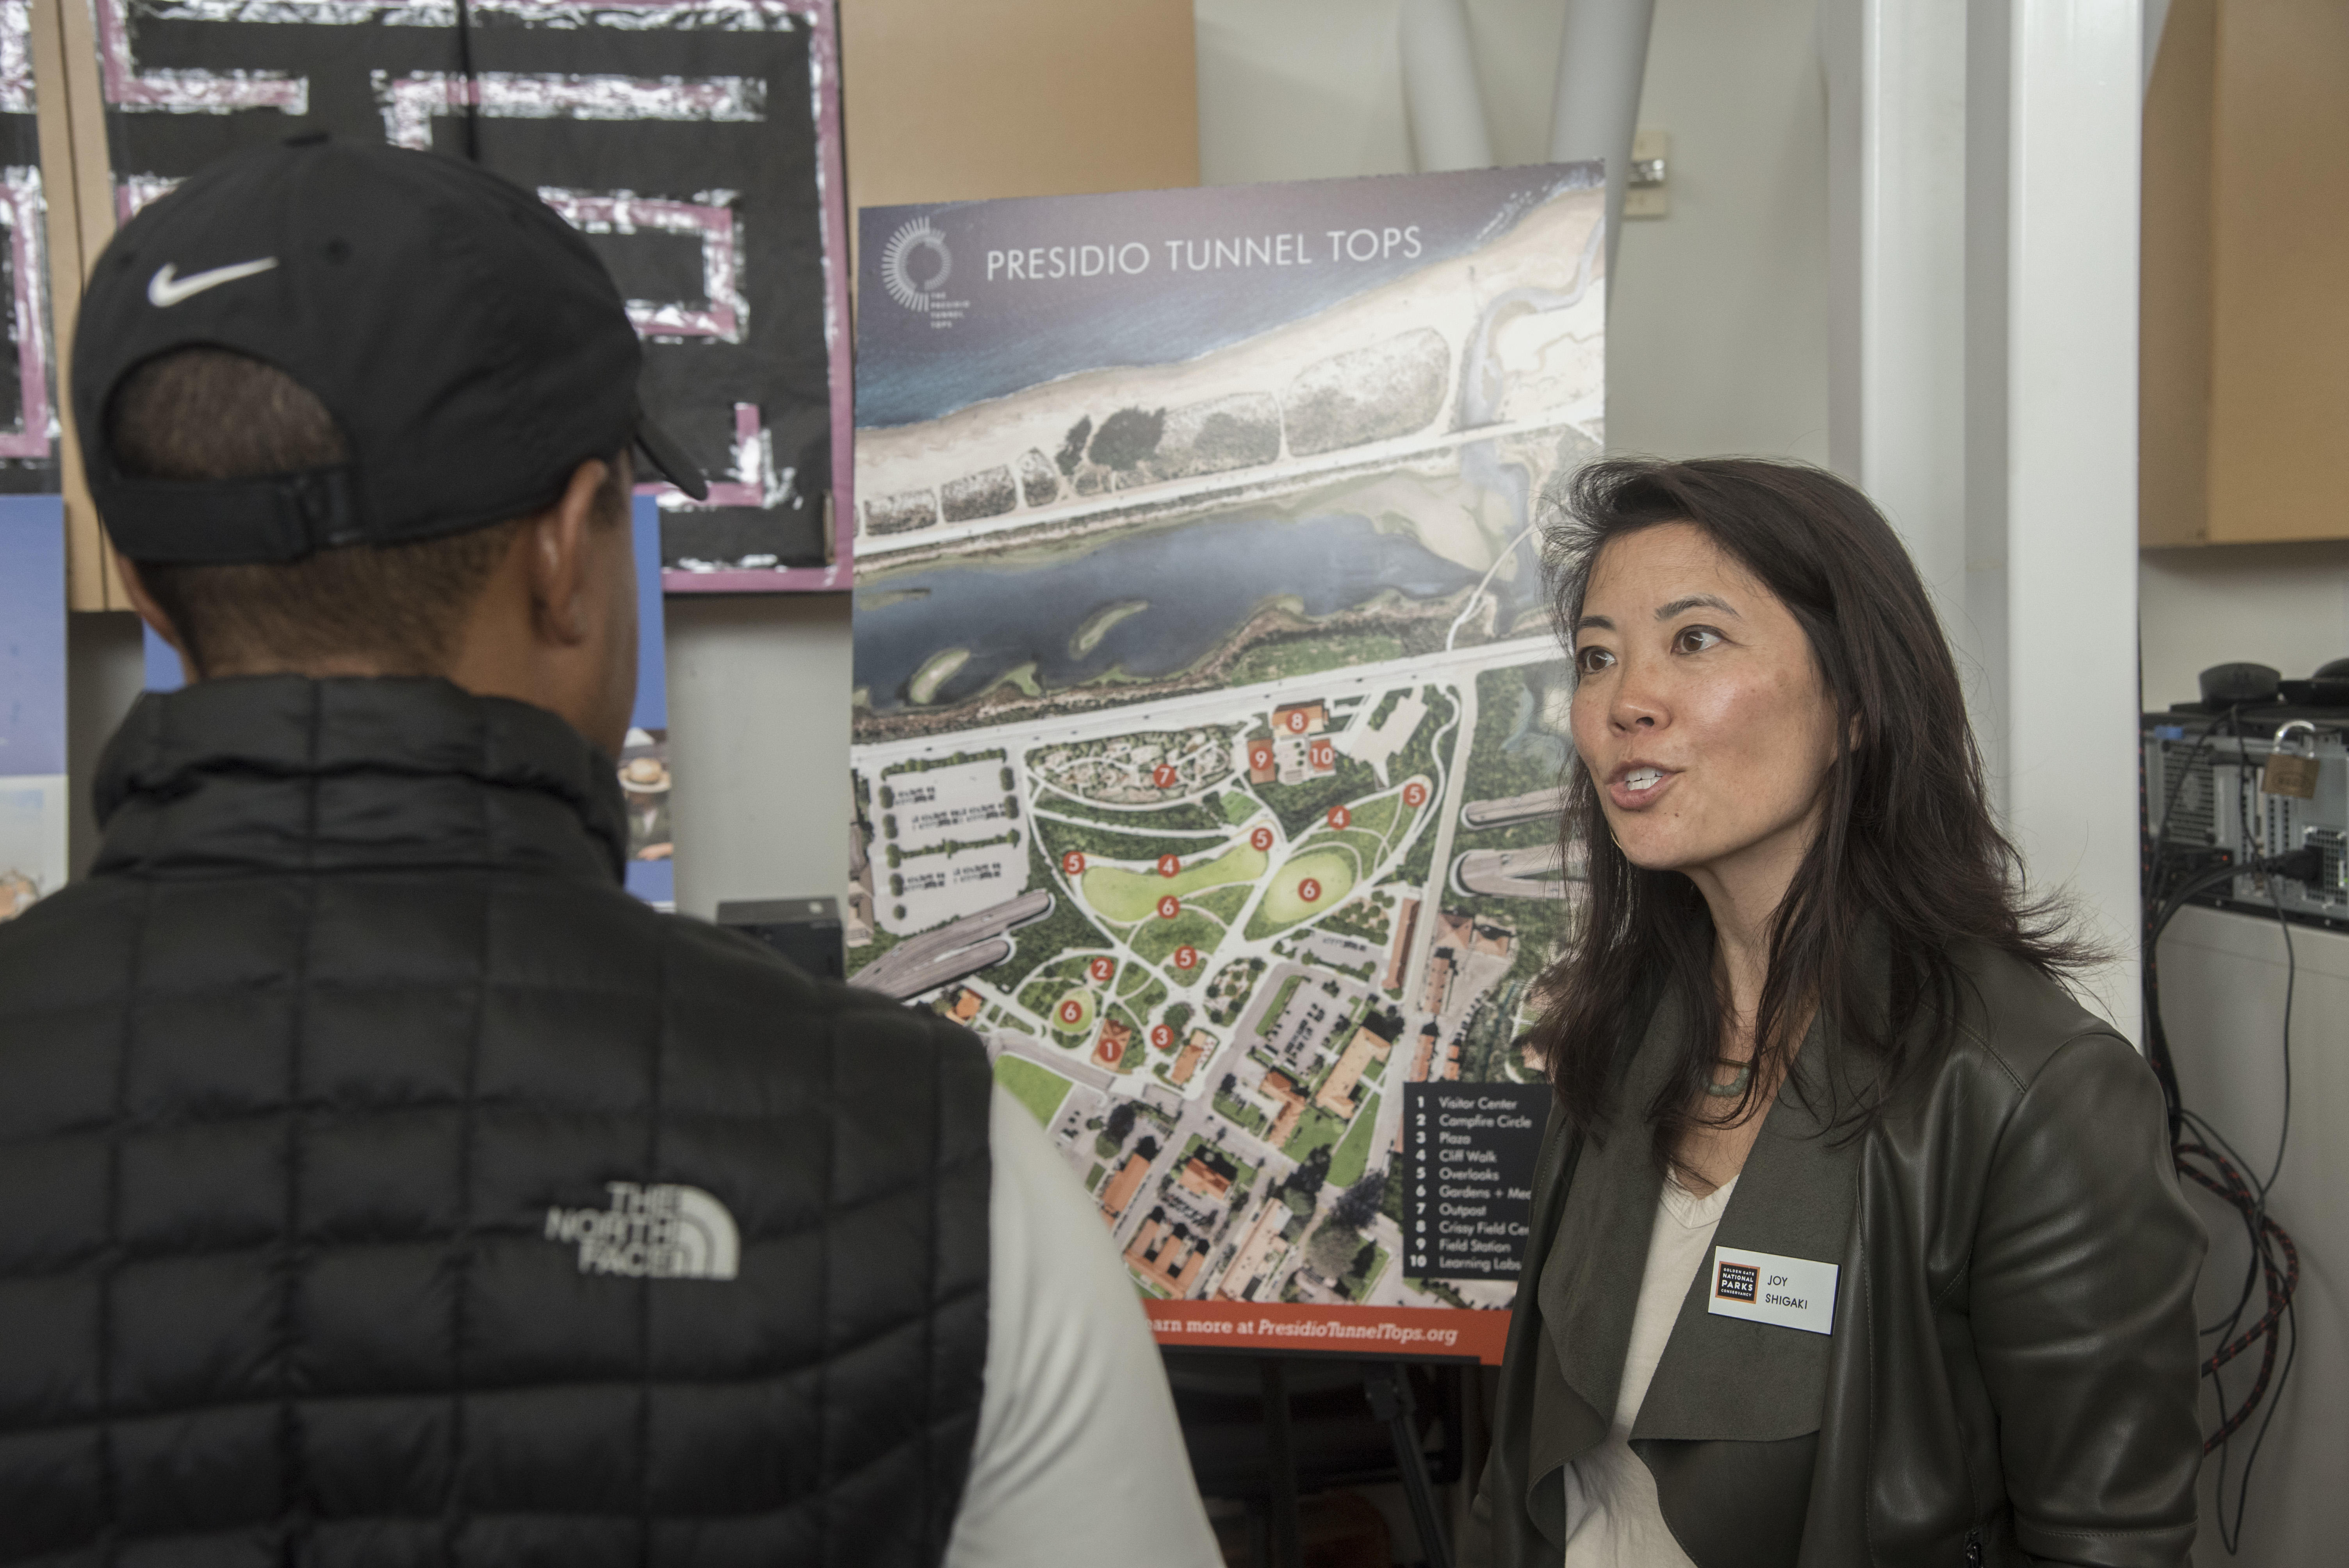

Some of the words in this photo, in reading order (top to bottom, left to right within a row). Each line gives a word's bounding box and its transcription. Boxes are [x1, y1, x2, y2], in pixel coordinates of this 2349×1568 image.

[987, 241, 1150, 282] PRESIDIO
[1165, 233, 1312, 272] TUNNEL
[1326, 225, 1422, 262] TOPS
[1291, 713, 1303, 730] 8
[1255, 751, 1267, 767] 9
[1310, 747, 1335, 765] 10
[1160, 768, 1170, 783] 7
[1410, 786, 1422, 805] 5
[1333, 811, 1344, 825] 4
[1257, 831, 1267, 847] 5
[1069, 855, 1079, 871] 5
[1163, 859, 1173, 872] 4
[1303, 882, 1315, 898] 6
[1162, 900, 1174, 915] 6
[1181, 950, 1191, 966] 5
[1097, 960, 1107, 977] 2
[1065, 1005, 1076, 1020] 6
[1157, 1028, 1167, 1045] 3
[1107, 1043, 1112, 1057] 1
[1417, 1096, 1424, 1108] 1
[1438, 1096, 1475, 1109] Visitor
[1477, 1096, 1517, 1110] Center
[1417, 1114, 1426, 1126] 2
[1439, 1114, 1495, 1129] Campfire
[1497, 1114, 1532, 1128] Circle
[1417, 1131, 1426, 1144] 3
[1439, 1131, 1471, 1145] Plaza
[1416, 1149, 1426, 1161] 4
[1439, 1149, 1464, 1162] Cliff
[1466, 1151, 1496, 1163] Walk
[1417, 1167, 1426, 1179] 5
[1439, 1167, 1500, 1181] Overlooks
[605, 1181, 677, 1213] THE
[1416, 1185, 1426, 1197] 6
[1439, 1185, 1490, 1199] Gardens
[1417, 1203, 1426, 1214] 7
[1439, 1203, 1486, 1218] Outpost
[545, 1206, 677, 1244] NORTH
[1416, 1220, 1426, 1232] 8
[1439, 1221, 1475, 1236] Crissy
[1477, 1221, 1506, 1235] Field
[1416, 1238, 1426, 1250] 9
[1439, 1238, 1468, 1252] Field
[1470, 1239, 1511, 1253] Station
[577, 1239, 677, 1278] FACE
[1410, 1255, 1427, 1267] 10
[1439, 1256, 1491, 1272] Learning
[1494, 1258, 1522, 1270] Labs
[1722, 1273, 1754, 1283] NATIONAL
[1722, 1279, 1753, 1292] PARKS
[1767, 1275, 1788, 1286] JOY
[1721, 1288, 1752, 1297] CONSERVANCY
[1765, 1294, 1807, 1310] SHIGAKI
[1186, 1320, 1232, 1335] more
[1236, 1320, 1254, 1335] at
[1257, 1319, 1458, 1346] PresidioTunnelTops.org
